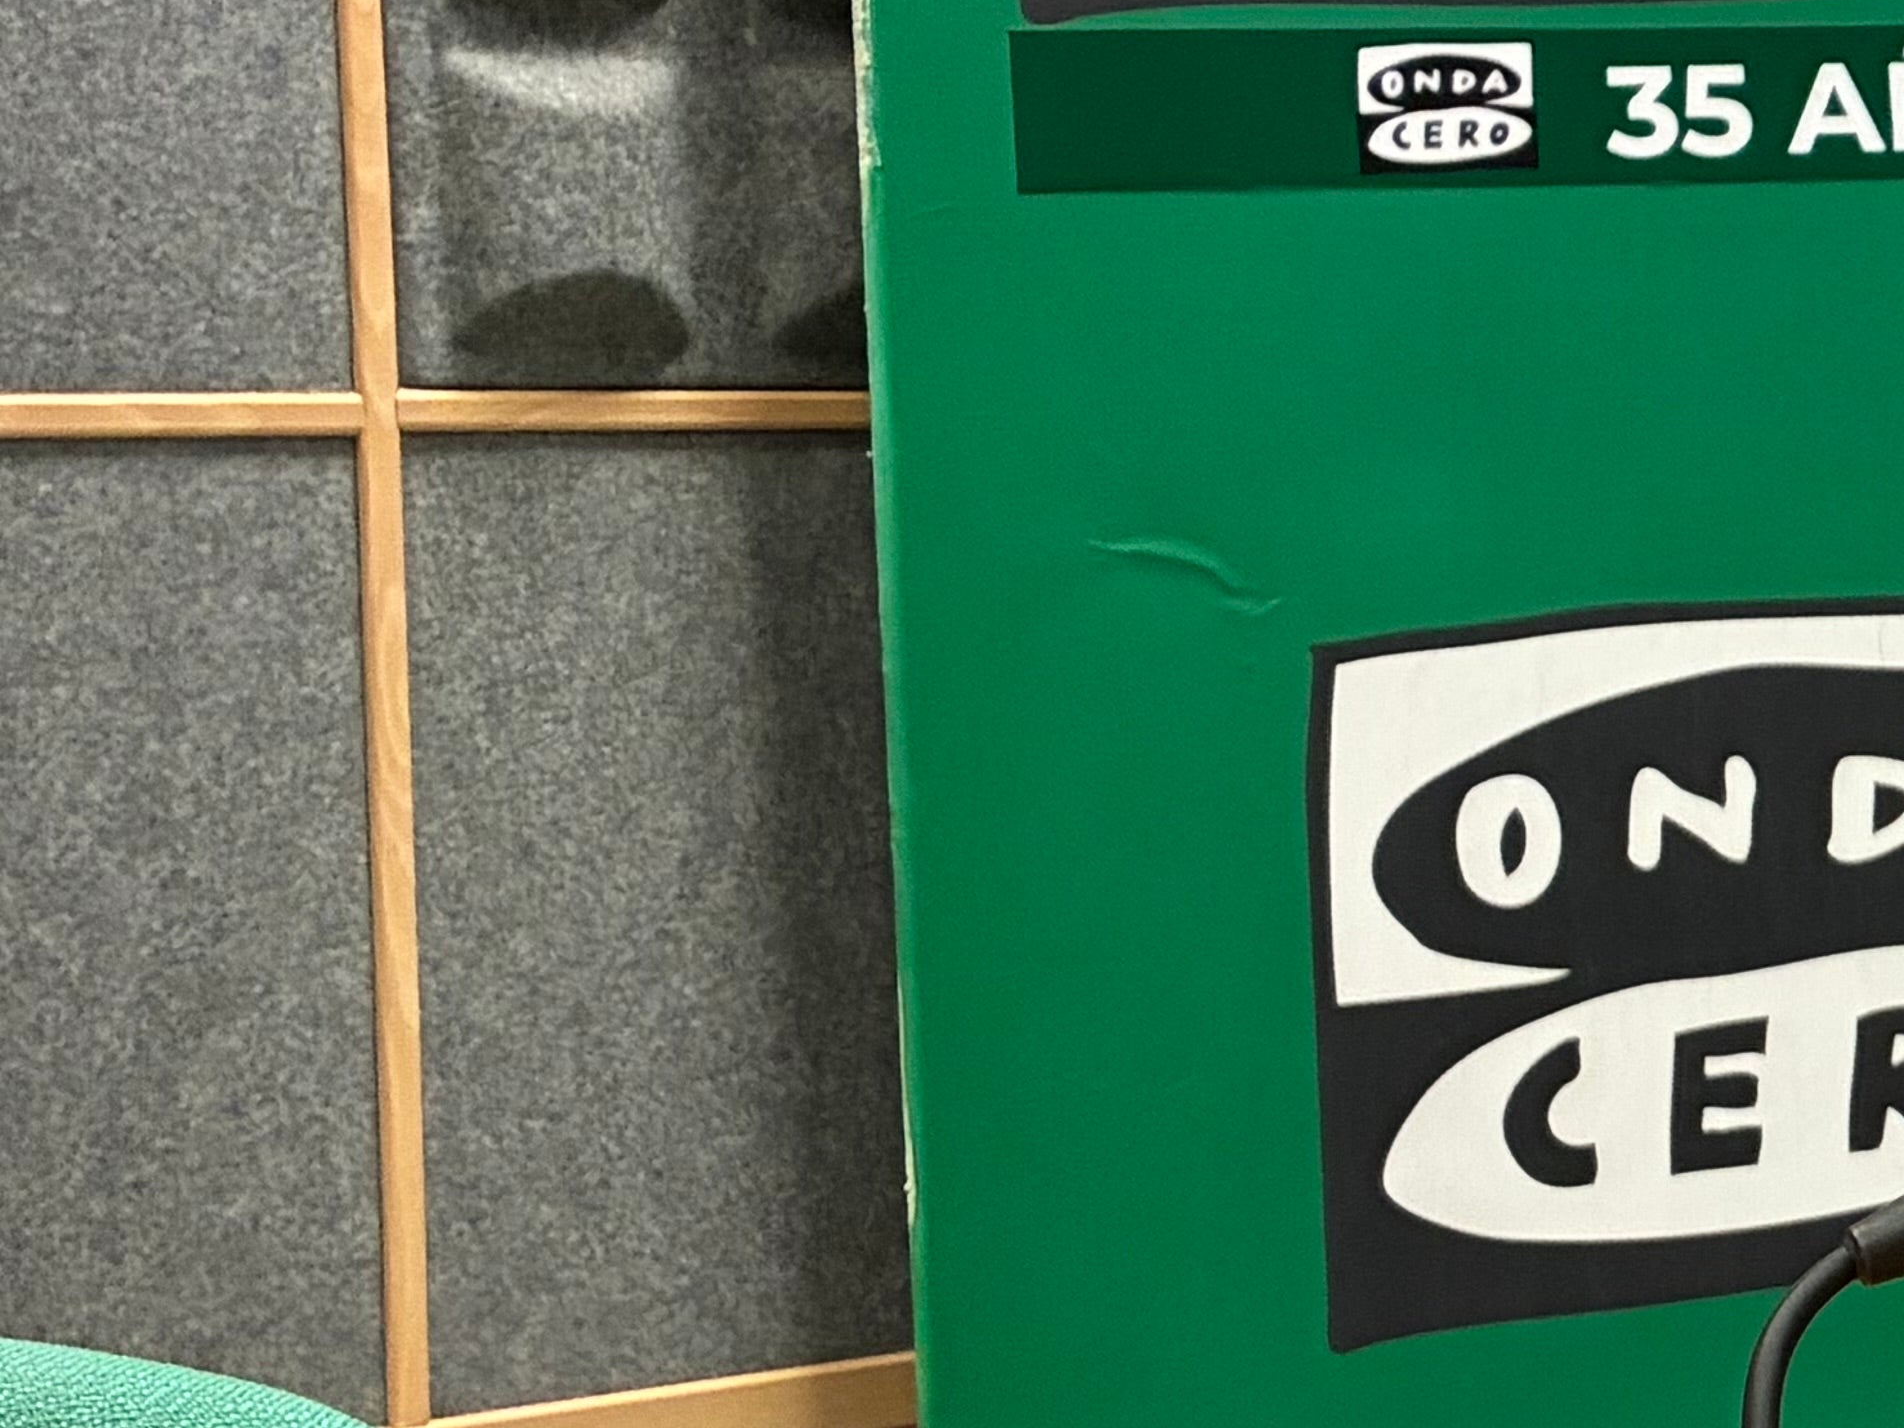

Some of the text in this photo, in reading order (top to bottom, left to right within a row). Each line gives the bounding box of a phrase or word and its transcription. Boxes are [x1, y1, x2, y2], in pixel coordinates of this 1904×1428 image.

[1380, 67, 1511, 100] ONDA
[1606, 63, 1754, 159] 35
[1391, 119, 1511, 151] CERO
